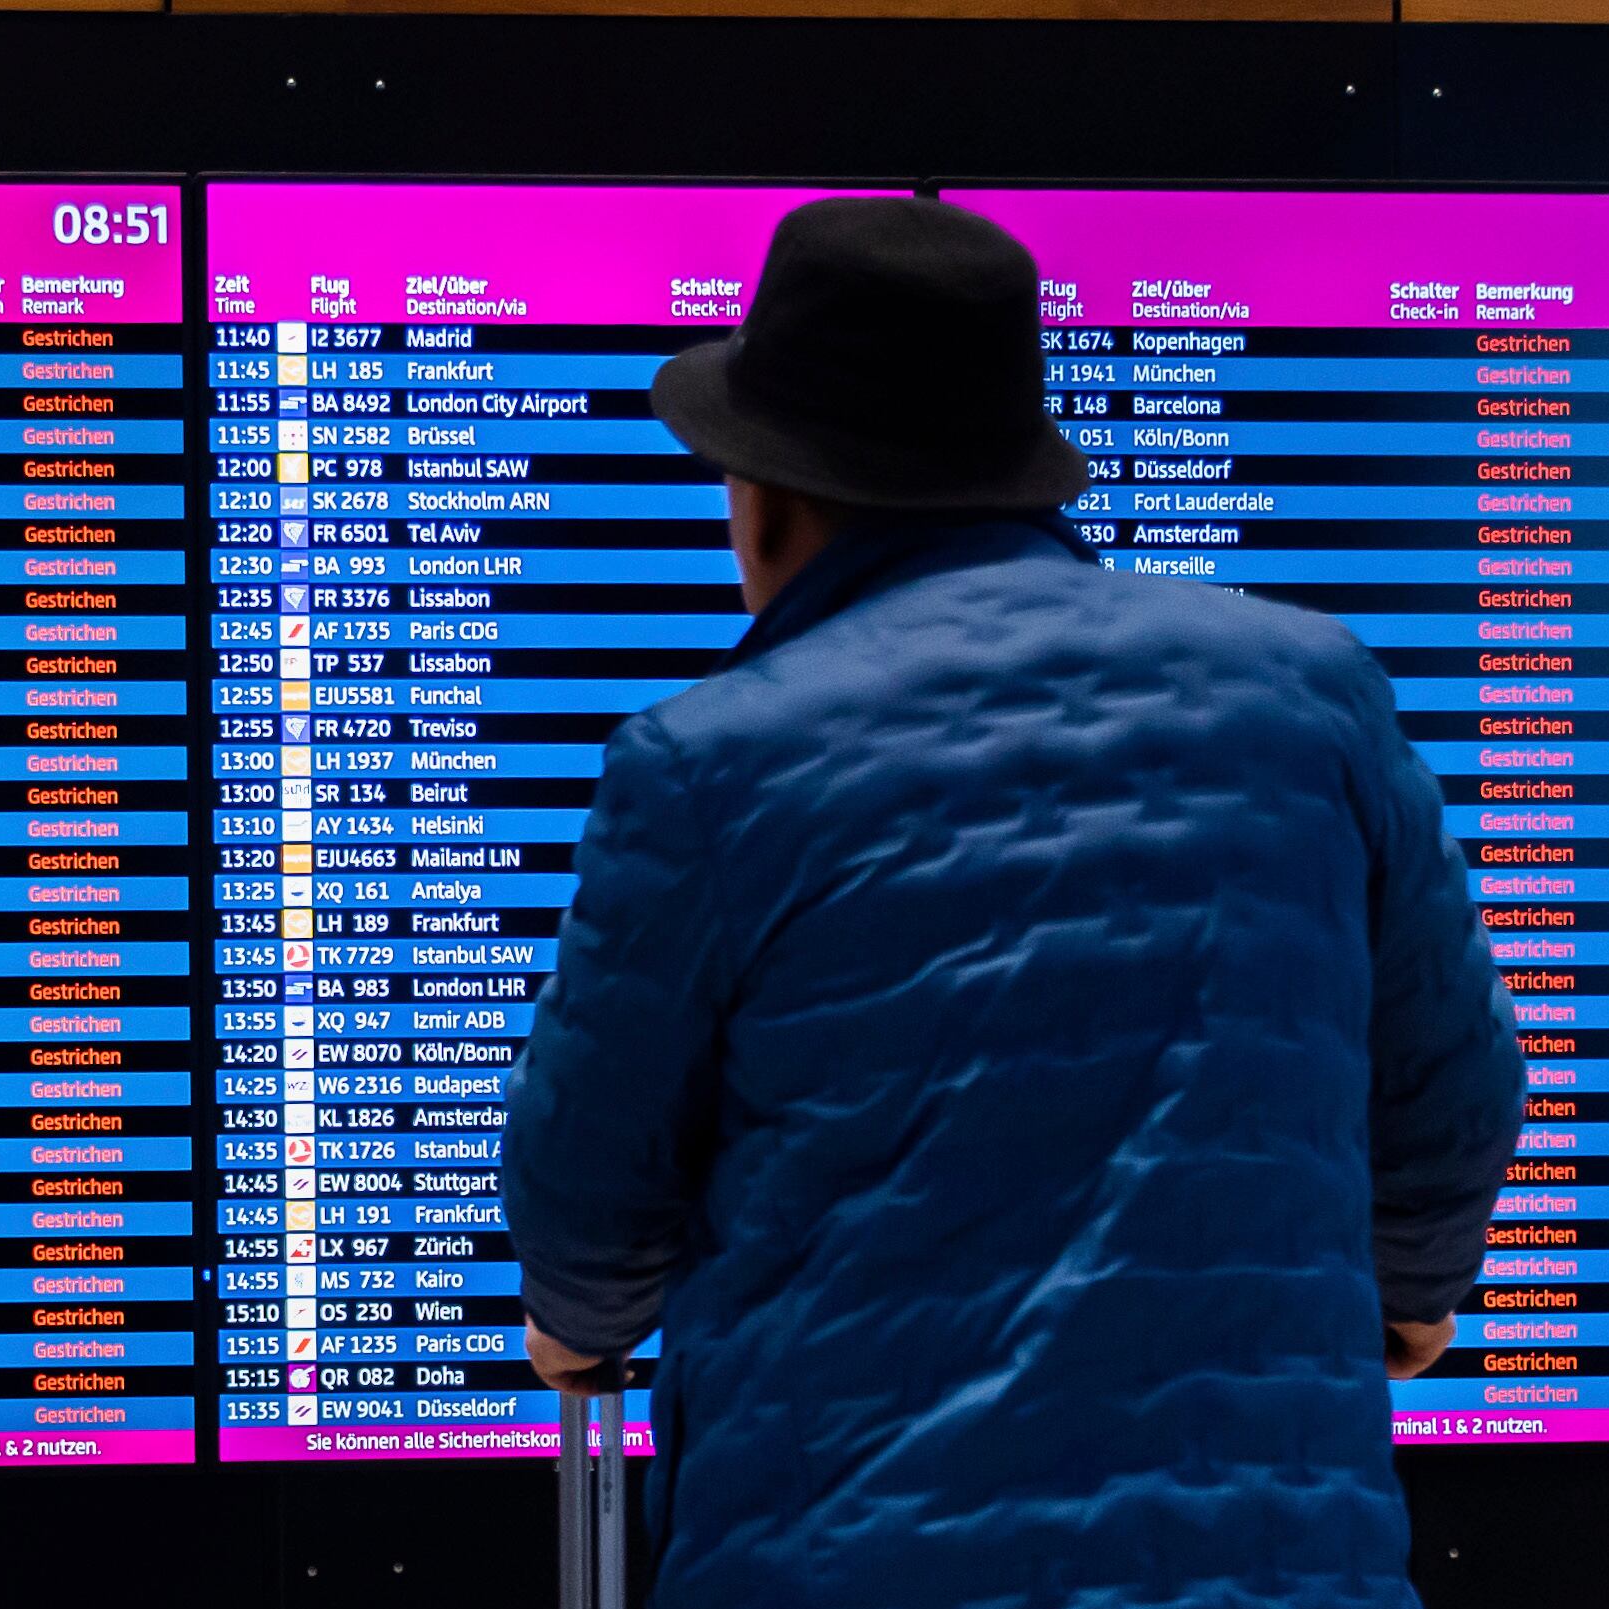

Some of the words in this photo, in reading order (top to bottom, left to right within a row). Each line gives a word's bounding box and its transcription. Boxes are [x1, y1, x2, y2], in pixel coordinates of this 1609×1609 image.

[53, 204, 169, 245] 08:51
[21, 275, 125, 299] Bemerkung
[214, 275, 250, 293] Zeit
[310, 275, 350, 298] Flug
[405, 275, 489, 297] Ziel/über
[670, 278, 743, 297] Schalter
[1040, 280, 1078, 302] Flug
[1131, 280, 1212, 301] Ziel/über
[1389, 281, 1460, 300] Schalter
[1476, 282, 1574, 304] Bemerkung
[22, 297, 85, 315] Remark
[214, 297, 256, 315] Time
[311, 297, 357, 319] Flight
[406, 297, 527, 317] Destination/via
[671, 299, 742, 317] Check-in
[1040, 300, 1084, 322] Flight
[1132, 301, 1250, 320] Destination/via
[1390, 303, 1459, 320] Check-in
[1476, 303, 1536, 320] Remark
[22, 329, 114, 347] Gestrichen
[216, 328, 271, 347] 11:40
[333, 328, 382, 348] 3677
[406, 328, 472, 348] Madrid
[1041, 332, 1063, 350] SK
[1068, 332, 1113, 350] 1674
[1133, 331, 1244, 356] Kopenhagen
[1476, 335, 1571, 354] Gestrichen
[22, 361, 114, 380] Gestrichen
[22, 394, 114, 413] Gestrichen
[217, 393, 271, 412] 11:55
[312, 393, 339, 413] BA
[342, 394, 391, 413] 8492
[407, 393, 478, 413] London
[482, 393, 519, 418] City
[521, 393, 588, 418] Airport
[22, 427, 115, 445] Gestrichen
[218, 491, 272, 510] 12:10
[312, 491, 337, 510] SK
[340, 491, 389, 510] 2678
[408, 490, 505, 511] Stockholm
[509, 492, 550, 511] ARN
[1077, 493, 1112, 511] 621
[1134, 493, 1171, 511] Fort
[1175, 492, 1274, 511] Lauderdale
[1477, 493, 1572, 513] Gestrichen
[24, 525, 116, 544] Gestrichen
[220, 686, 273, 705] 12:55
[315, 686, 395, 706] EJU5581
[410, 685, 482, 706] Funchal
[223, 1044, 278, 1064] 14:20
[318, 1044, 350, 1063] EW
[353, 1043, 402, 1063] 8070
[414, 1042, 512, 1064] Köln/Bonn
[32, 1242, 124, 1262] Gestrichen
[227, 1401, 280, 1420] 15:35
[322, 1400, 352, 1419] EW
[356, 1400, 404, 1418] 9041
[417, 1398, 517, 1418] Düsseldorf
[5, 1440, 19, 1457] &
[22, 1439, 34, 1456] 2
[37, 1438, 102, 1457] nutzen.
